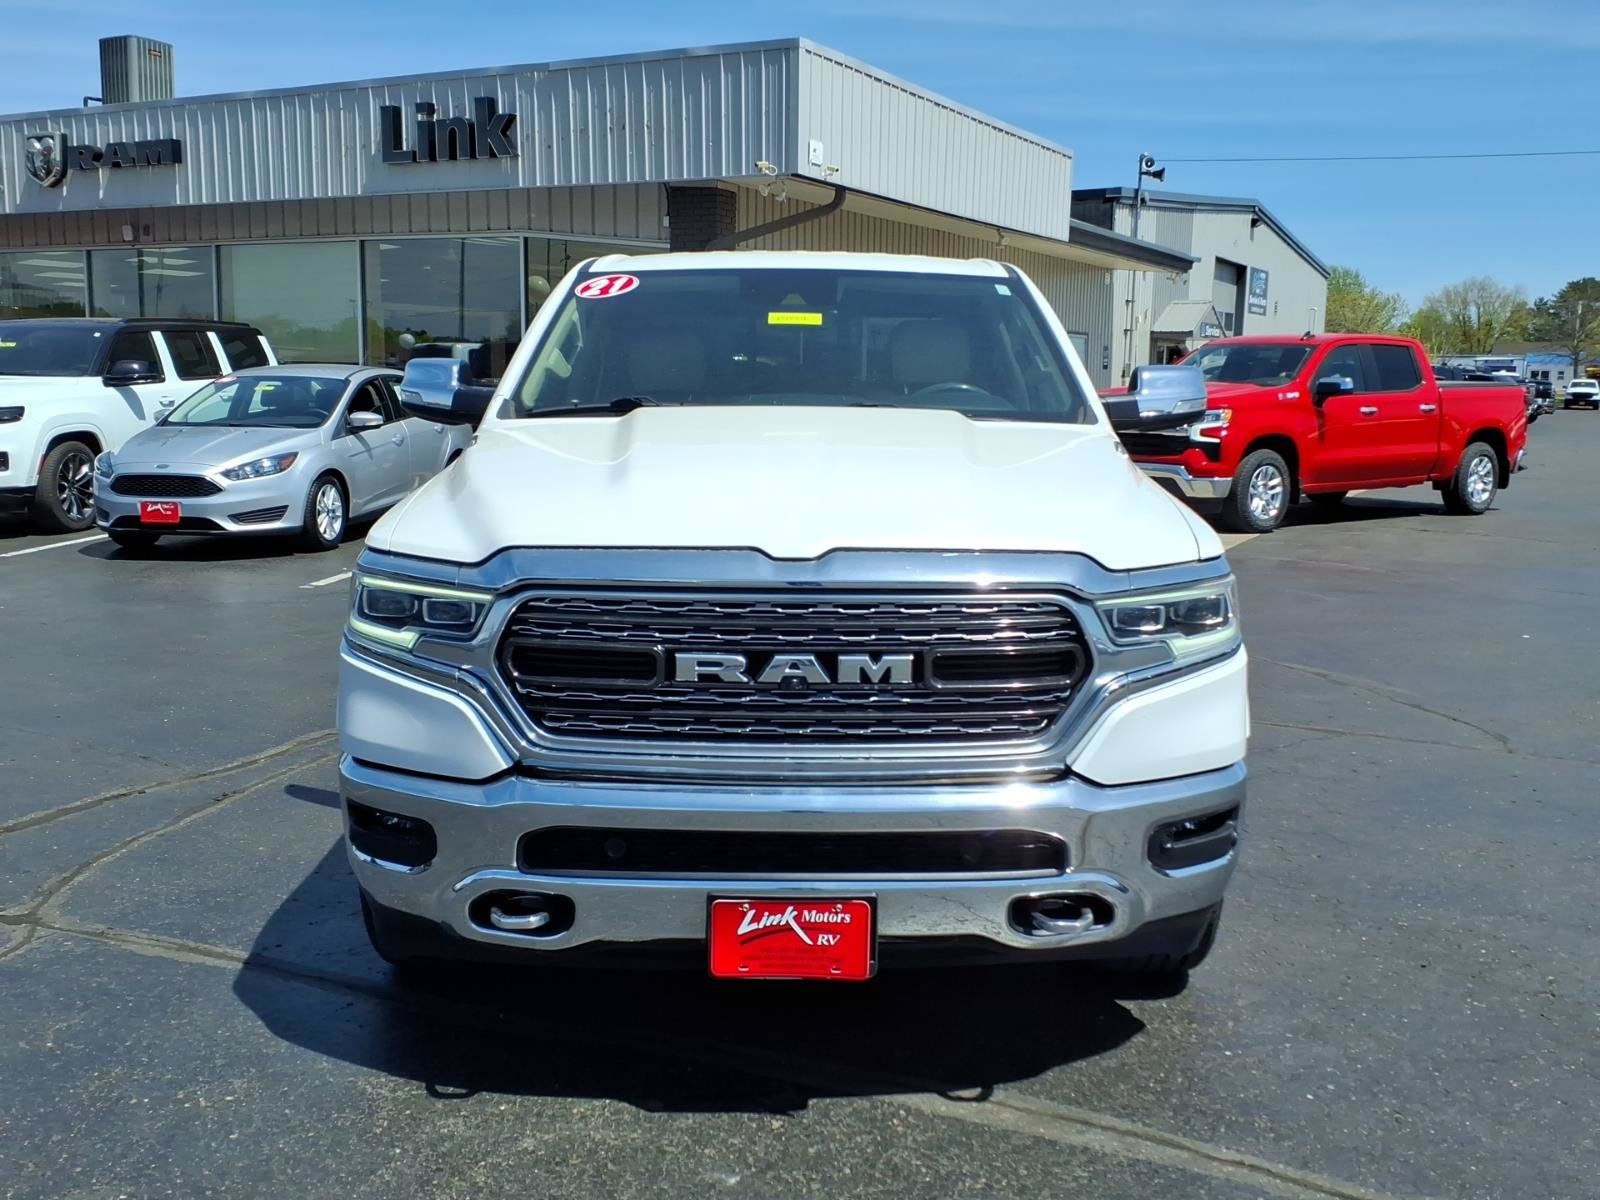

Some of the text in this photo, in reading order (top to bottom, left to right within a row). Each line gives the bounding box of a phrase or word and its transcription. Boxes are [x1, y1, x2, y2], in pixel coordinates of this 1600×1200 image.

[380, 96, 517, 163] Link
[68, 138, 181, 171] RAM
[580, 276, 630, 297] 21
[675, 652, 914, 684] RAM
[736, 905, 851, 946] Link Motors
[816, 933, 841, 946] RV
